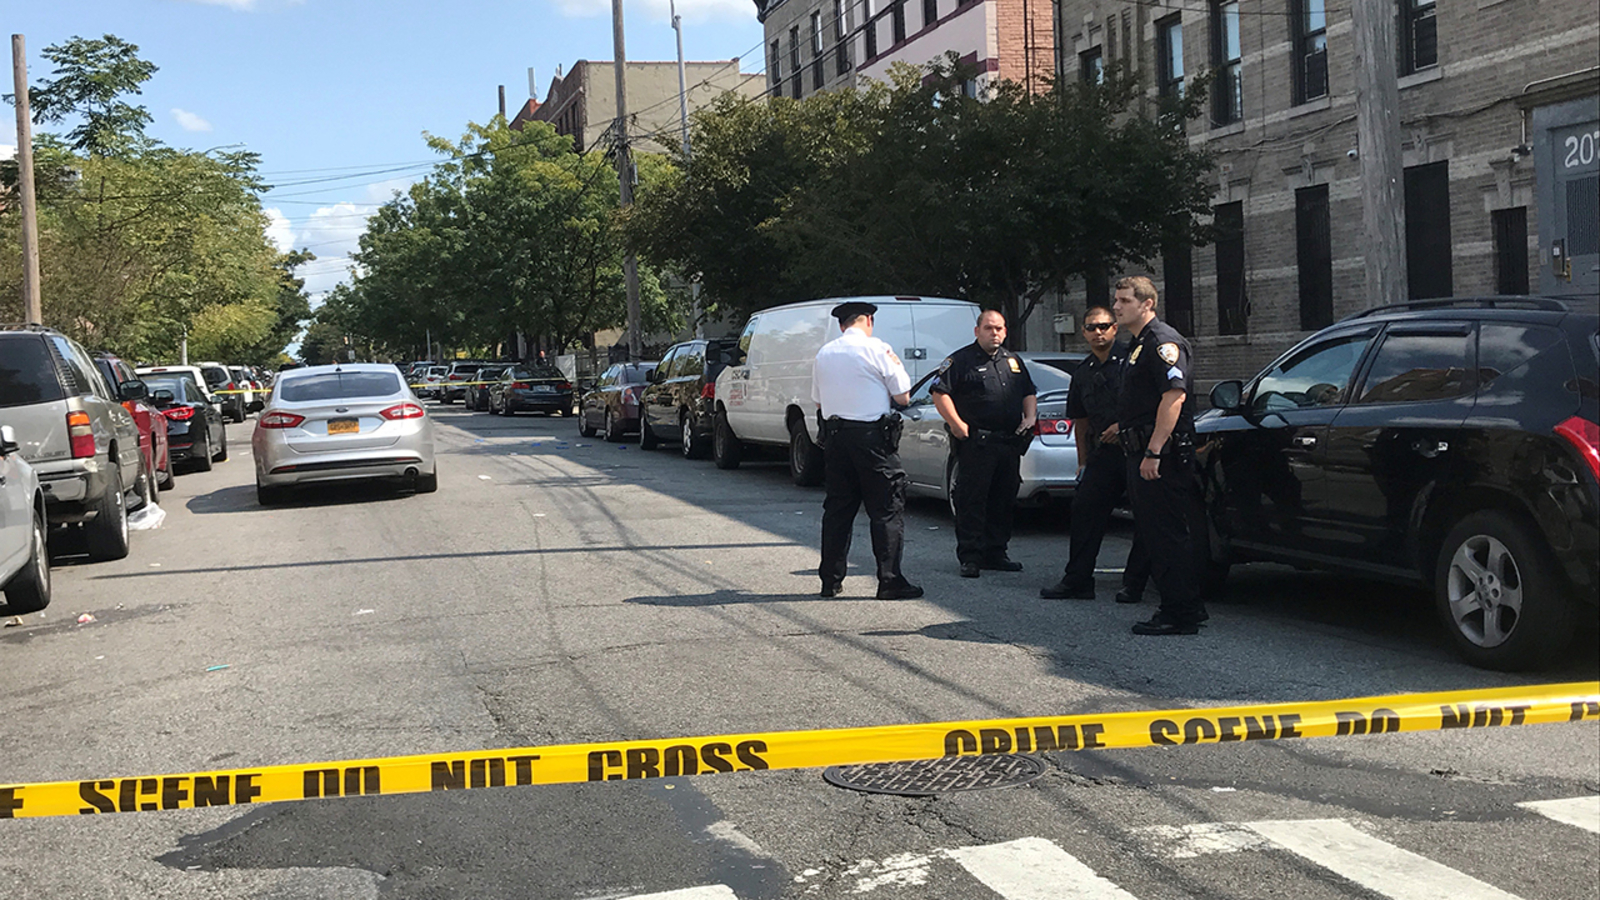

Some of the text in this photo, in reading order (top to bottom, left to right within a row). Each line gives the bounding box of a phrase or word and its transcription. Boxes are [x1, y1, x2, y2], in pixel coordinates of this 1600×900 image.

[1564, 131, 1600, 168] 20
[79, 774, 262, 814] SCENE
[303, 766, 380, 798] DO
[431, 755, 540, 790] NOT
[588, 740, 769, 781] CROSS
[944, 723, 1106, 756] CRIME
[1149, 714, 1303, 745] SCENE
[1439, 703, 1532, 729] NOT
